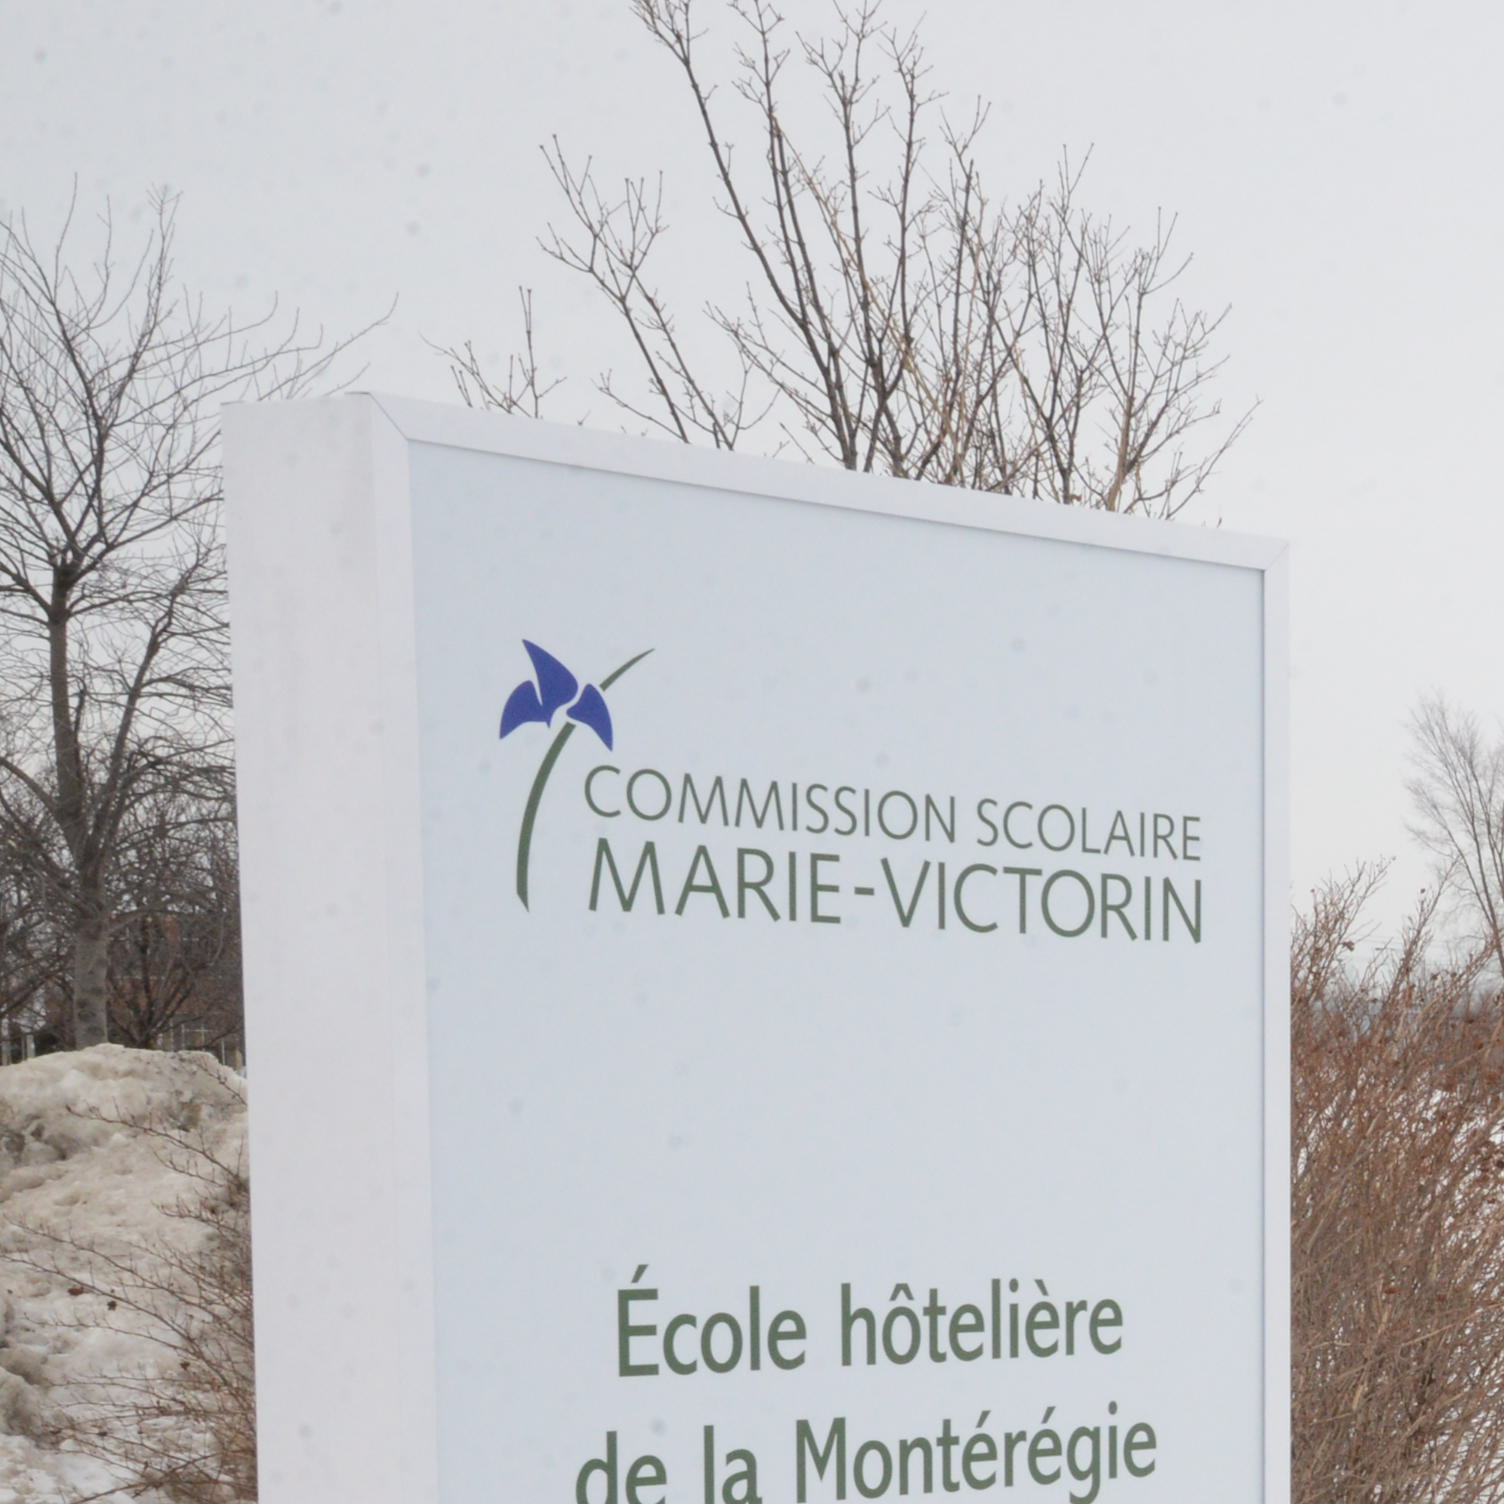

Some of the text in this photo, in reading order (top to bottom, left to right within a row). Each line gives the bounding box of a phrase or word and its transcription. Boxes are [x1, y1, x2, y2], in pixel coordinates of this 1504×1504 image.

[584, 764, 1201, 862] COMMISSION SCOLAIRE
[588, 837, 1202, 945] MARIE-VICTORIN
[617, 1263, 1124, 1378] École hôtelière
